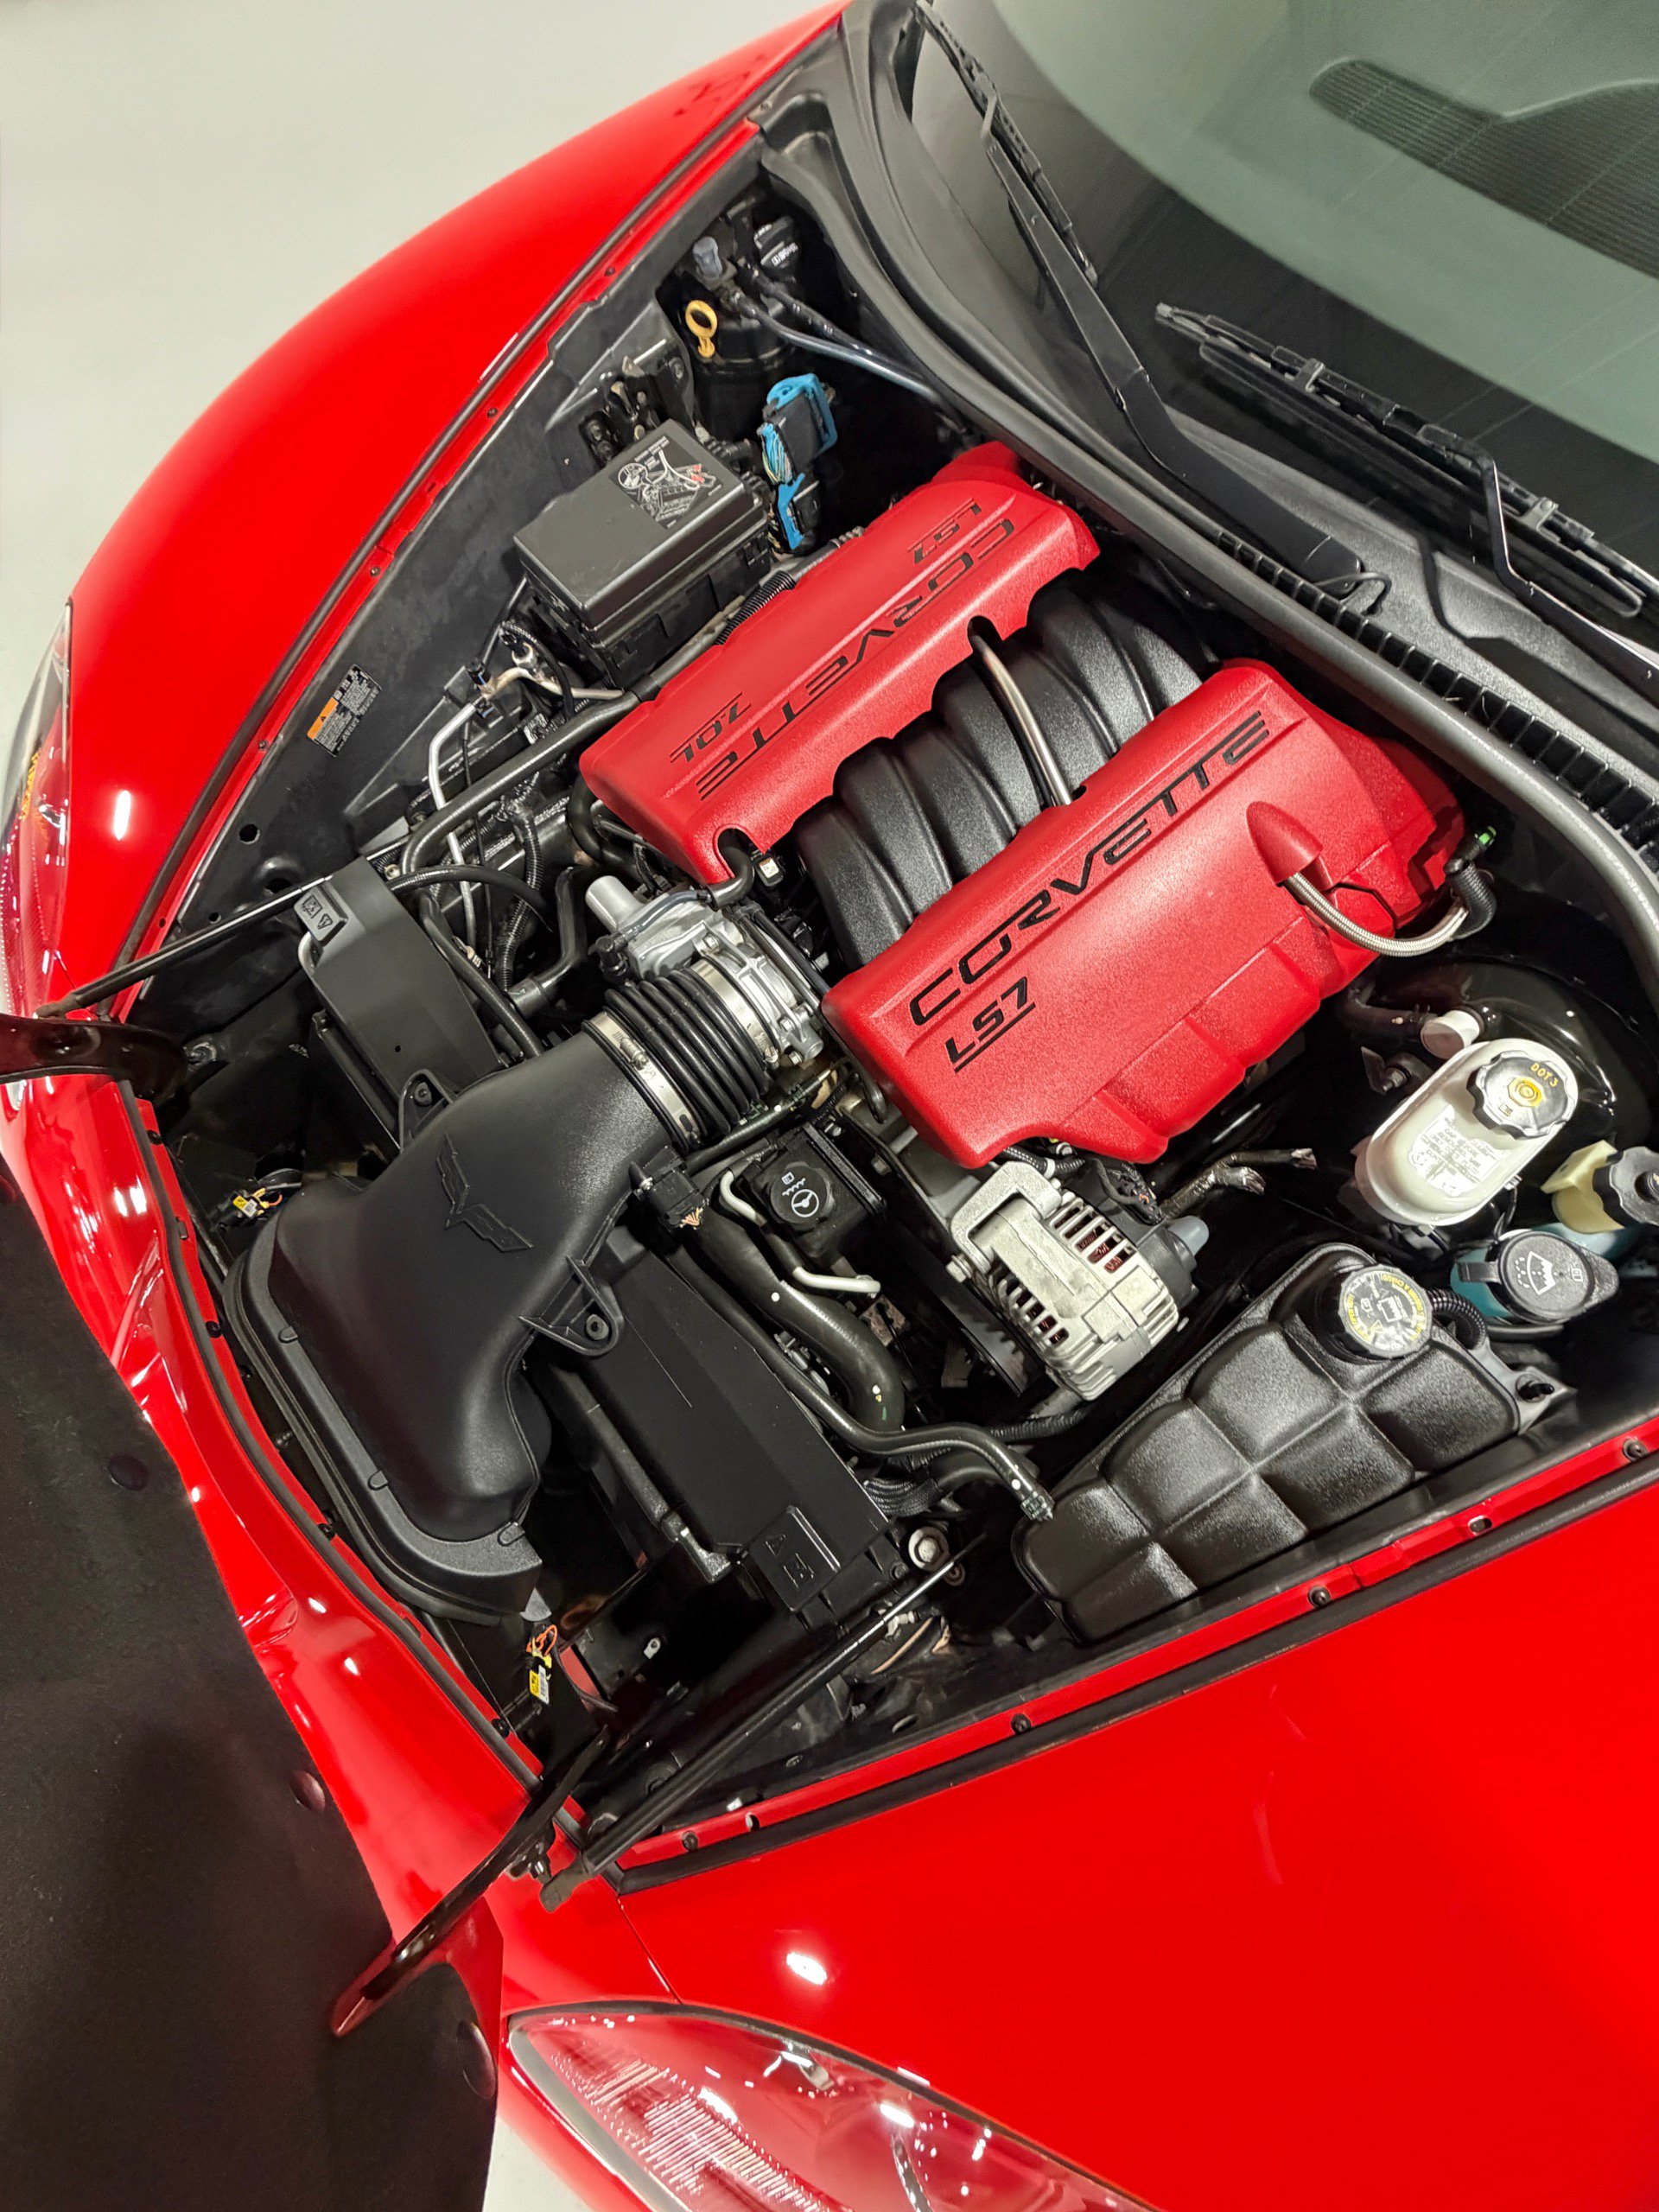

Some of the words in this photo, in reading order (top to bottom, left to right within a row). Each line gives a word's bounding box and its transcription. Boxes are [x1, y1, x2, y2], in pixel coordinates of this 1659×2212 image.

[911, 500, 982, 563] LS7
[696, 518, 1015, 801] CORVETTE
[909, 710, 1270, 1027] CORVETTE
[945, 976, 1030, 1065] LS7
[1530, 1062, 1553, 1081] DOT
[1549, 1077, 1559, 1087] 3
